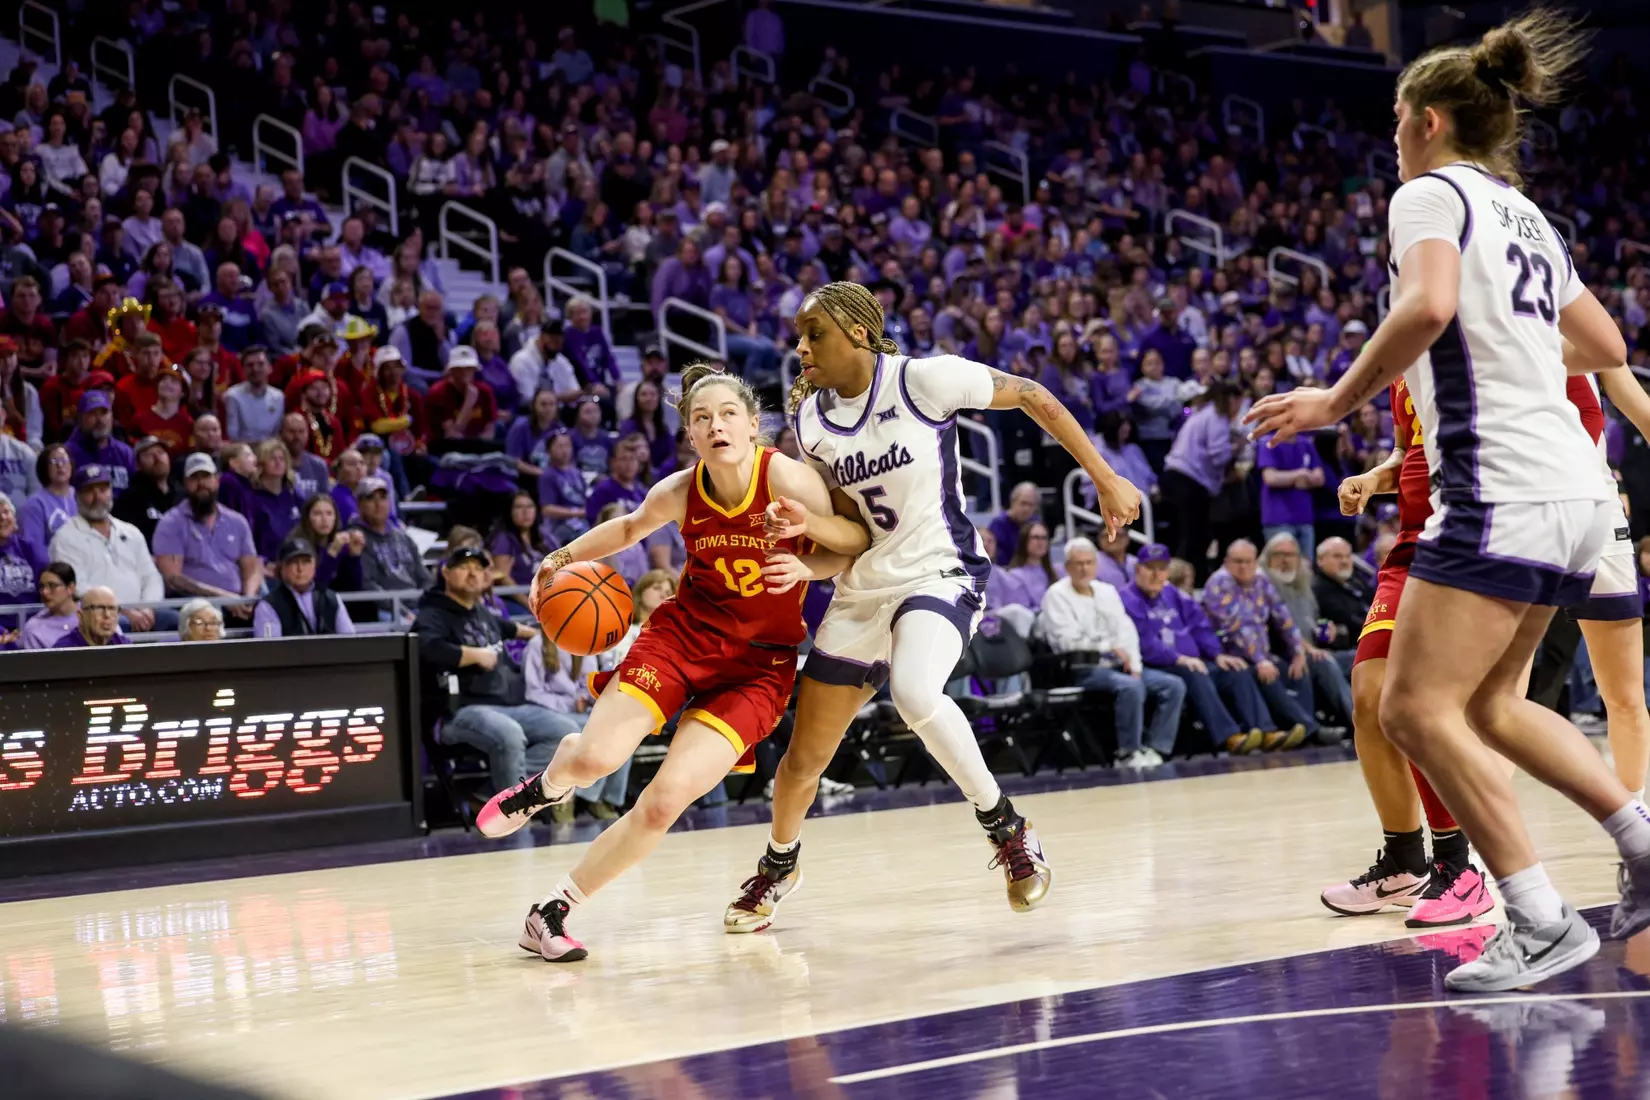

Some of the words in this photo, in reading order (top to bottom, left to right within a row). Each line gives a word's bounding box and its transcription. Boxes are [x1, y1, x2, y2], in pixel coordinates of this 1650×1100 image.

[1505, 241, 1556, 327] 23
[829, 440, 915, 487] Wildcats
[858, 484, 900, 532] 5
[695, 534, 728, 552] IOWA
[714, 557, 765, 598] 12
[625, 667, 662, 692] STATE
[71, 688, 384, 798] Briggs
